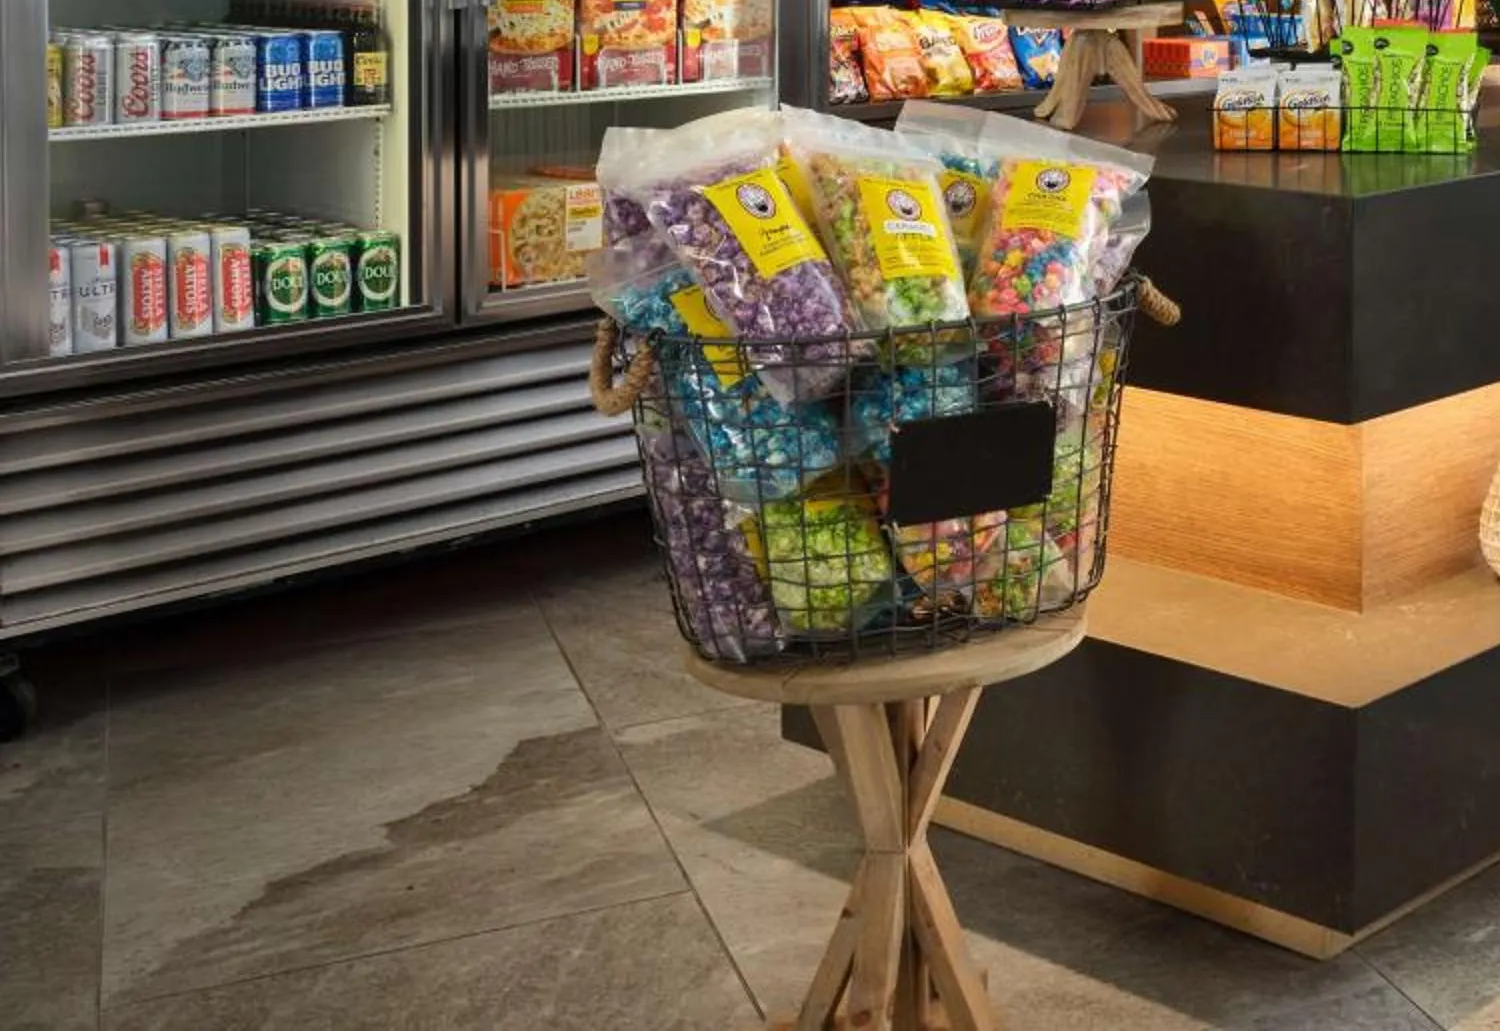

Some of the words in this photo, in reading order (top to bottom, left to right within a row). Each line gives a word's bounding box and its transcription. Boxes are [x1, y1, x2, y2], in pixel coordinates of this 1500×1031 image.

[266, 62, 300, 77] BUD
[309, 59, 343, 73] BUD
[122, 49, 149, 117] Coors
